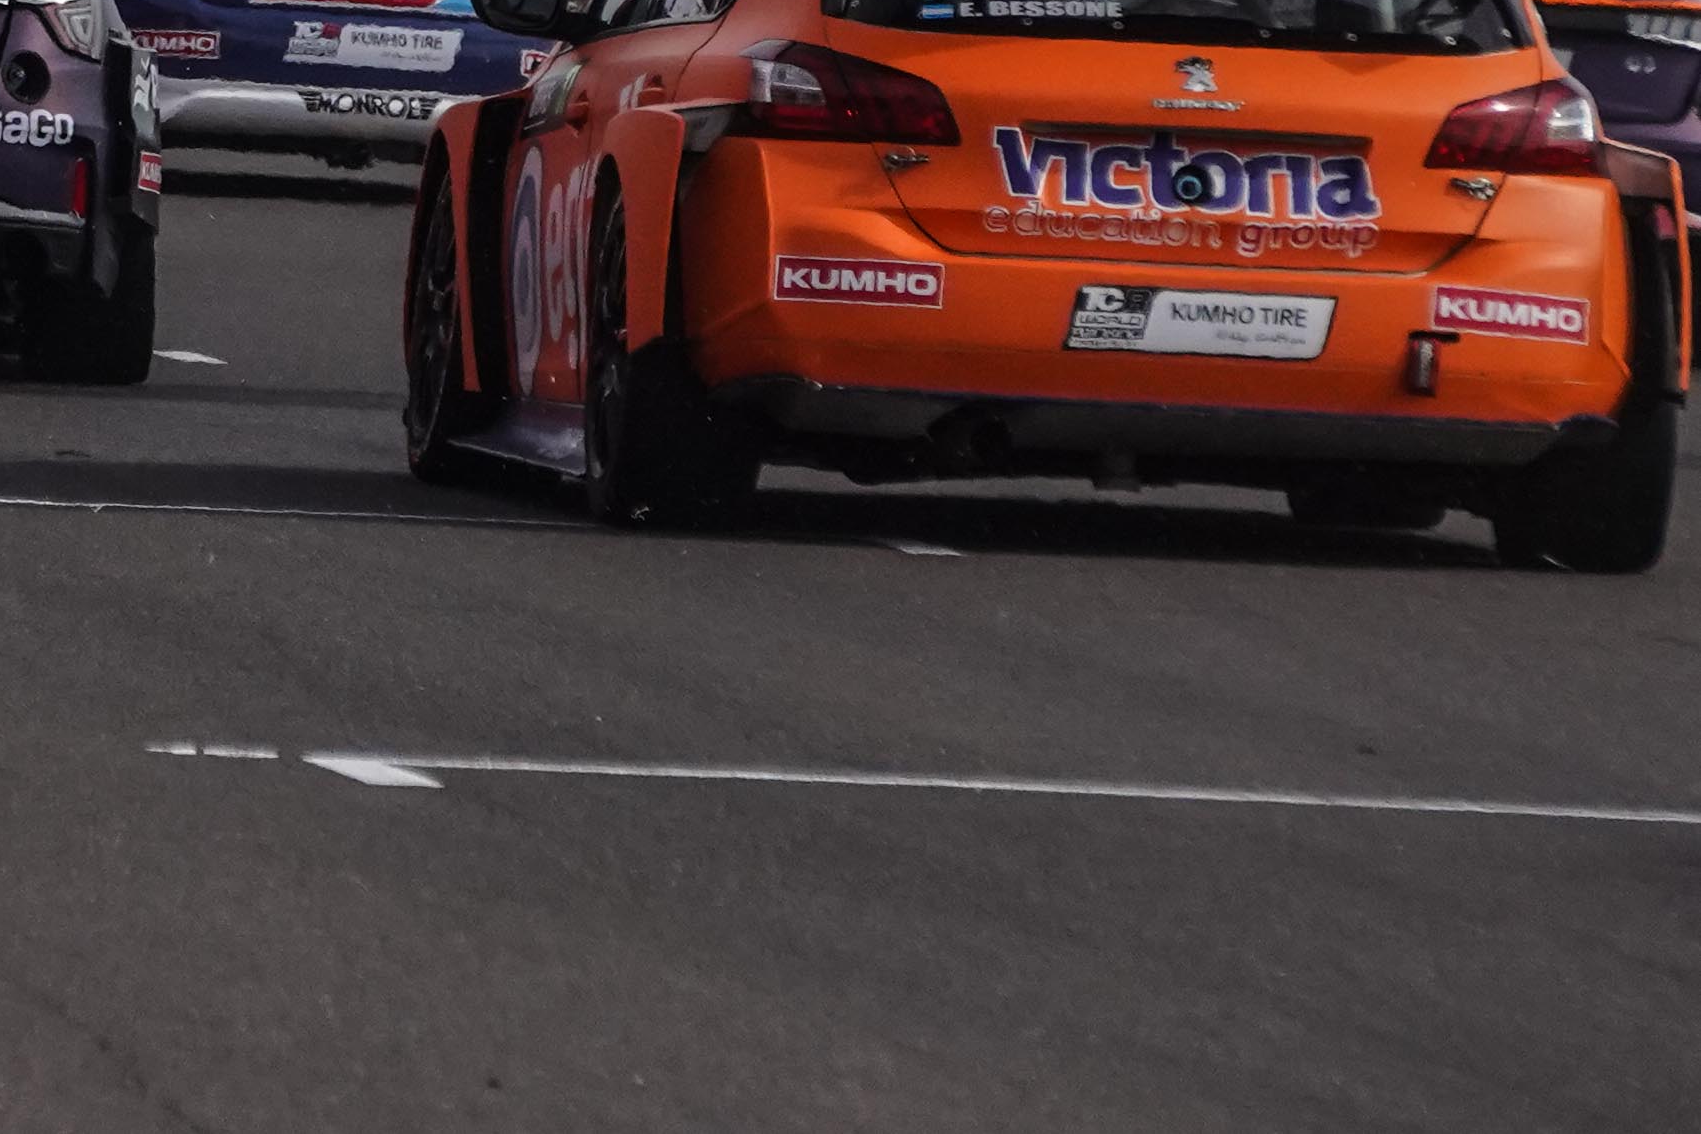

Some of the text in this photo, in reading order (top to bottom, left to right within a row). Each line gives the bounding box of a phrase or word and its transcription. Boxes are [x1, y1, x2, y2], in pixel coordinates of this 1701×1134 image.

[959, 0, 1124, 18] E. BESSONE
[352, 31, 408, 48] KUMHO
[413, 34, 444, 50] TIRE
[993, 125, 1382, 222] Victoria
[984, 200, 1380, 258] education group
[782, 267, 938, 297] KUMHO
[1171, 302, 1309, 329] KUMHO TIRE
[1438, 295, 1583, 333] KUMHO
